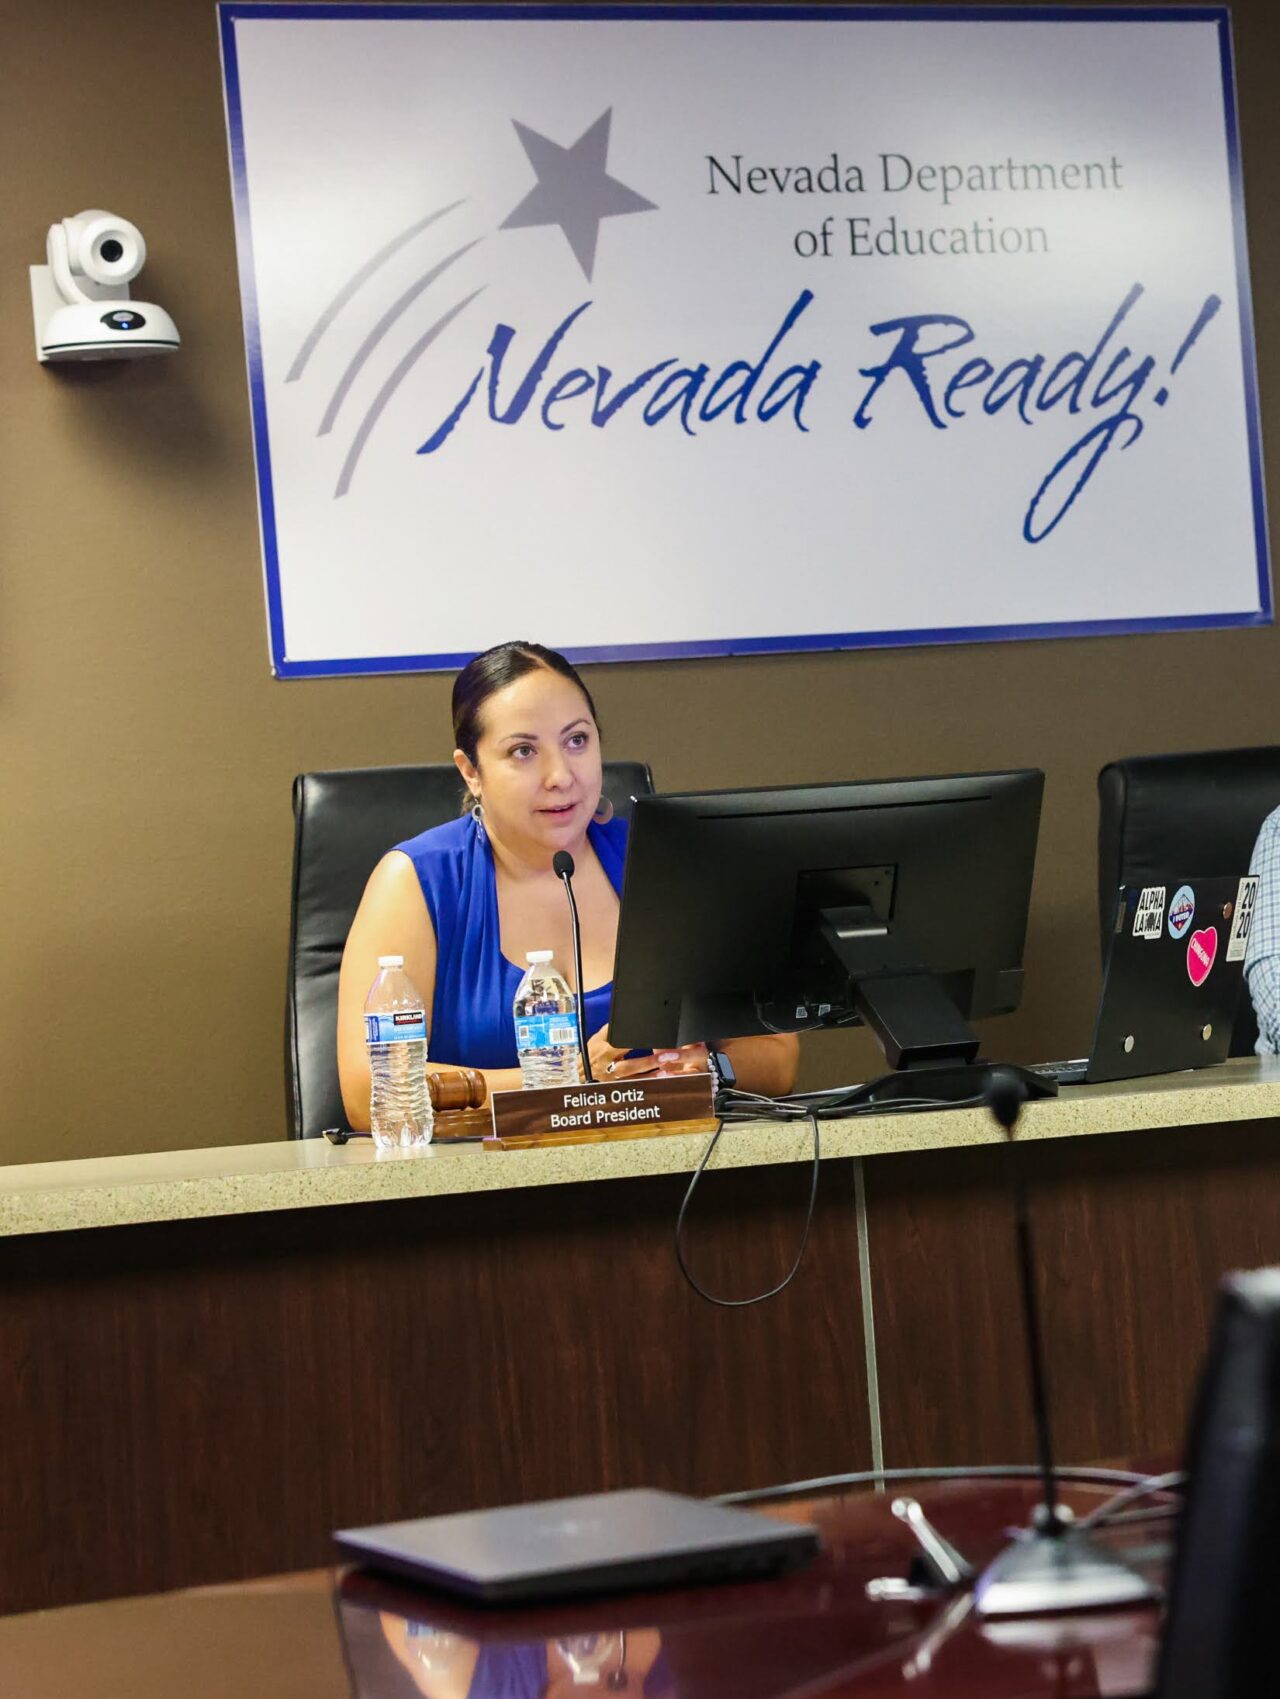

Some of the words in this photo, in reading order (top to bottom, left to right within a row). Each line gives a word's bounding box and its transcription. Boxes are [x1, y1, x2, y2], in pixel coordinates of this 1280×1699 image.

[705, 153, 865, 195] Nevada
[879, 152, 1124, 205] Department
[793, 216, 833, 258] of
[846, 216, 1050, 257] Education
[416, 289, 822, 455] Nevada
[852, 283, 1222, 544] Ready!
[1139, 890, 1164, 911] ALPHA
[1242, 882, 1255, 909] 20
[1135, 911, 1160, 933] LANA
[1236, 911, 1250, 938] 20
[563, 1092, 606, 1108] Felicia
[611, 1089, 645, 1104] Ortiz
[551, 1111, 592, 1128] Board
[596, 1105, 661, 1123] President
